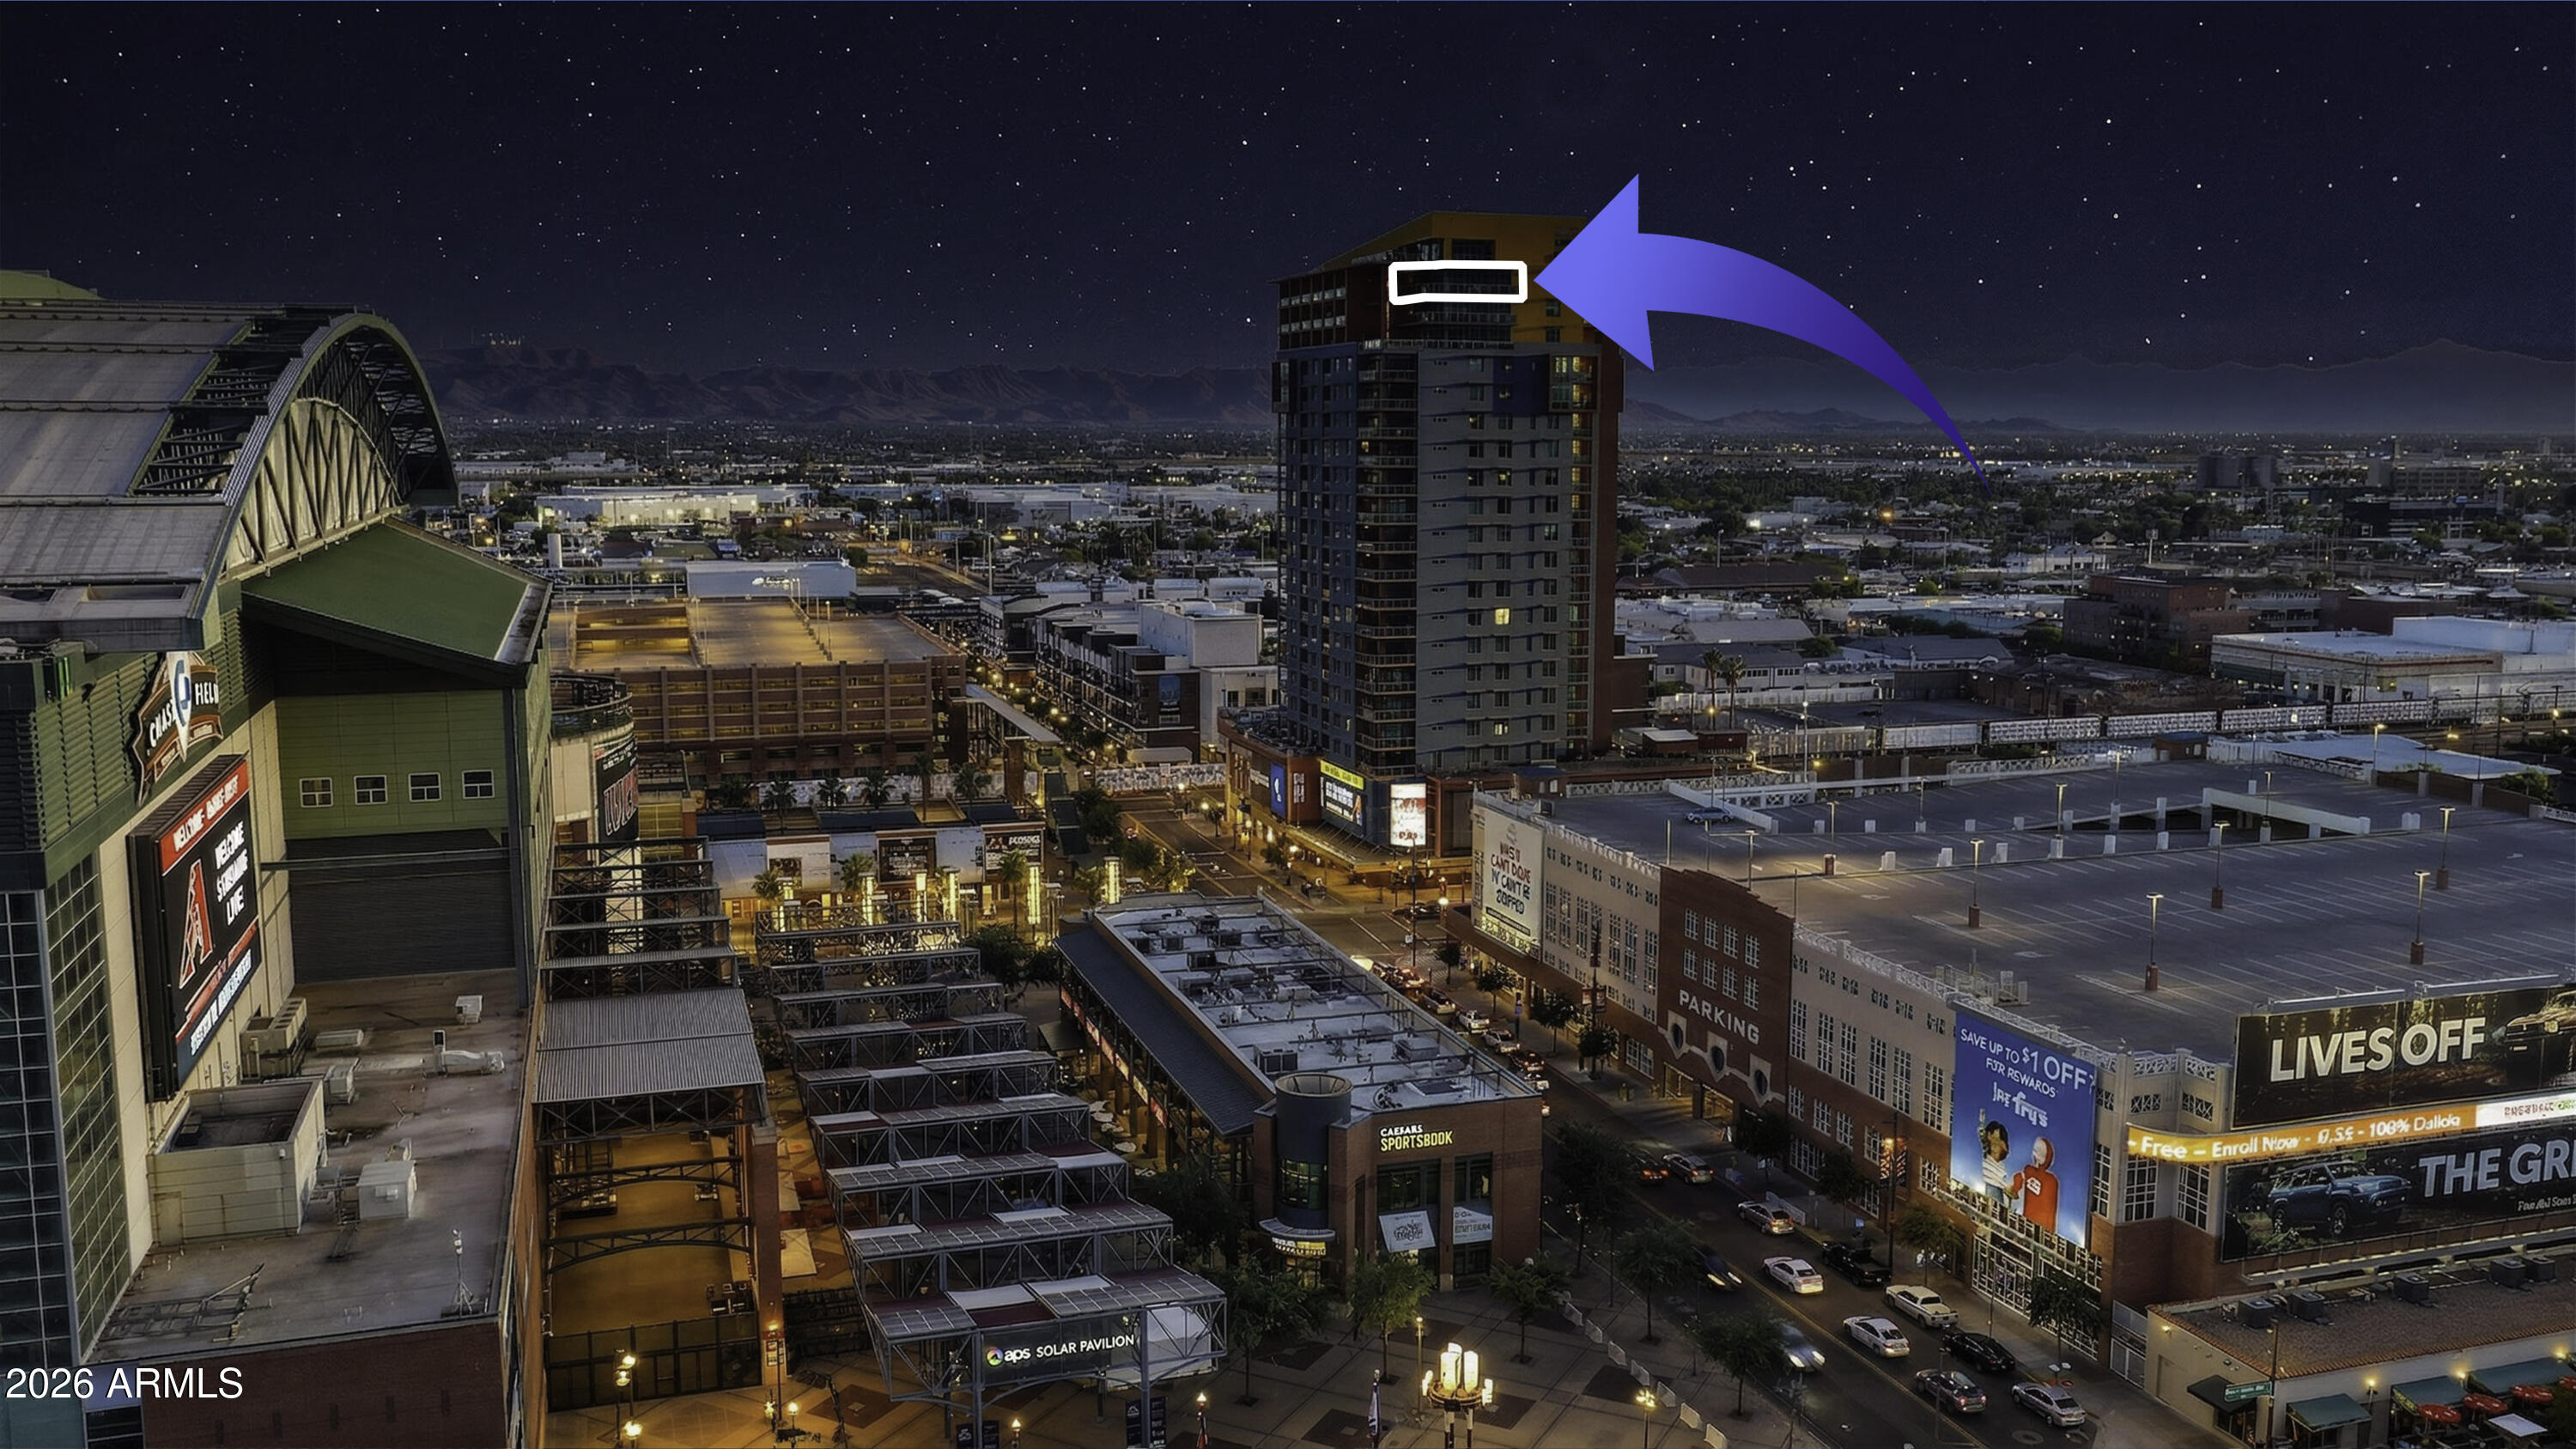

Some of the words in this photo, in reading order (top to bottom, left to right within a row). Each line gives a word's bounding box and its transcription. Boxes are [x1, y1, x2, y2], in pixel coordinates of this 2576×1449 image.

[1680, 989, 1759, 1044] PARKING
[1960, 1028, 1987, 1050] SAVE
[1989, 1040, 2003, 1056] UP
[2005, 1047, 2020, 1064] TO
[2022, 1047, 2038, 1073] $1
[2270, 1027, 2394, 1082] LIVES
[2401, 1017, 2486, 1067] OFF
[1381, 1130, 1453, 1152] SPORTSBOOK
[2141, 1135, 2188, 1159] Free
[2212, 1135, 2257, 1158] Enroll
[2419, 1148, 2501, 1197] THE
[1004, 1348, 1030, 1363] aps
[1036, 1342, 1077, 1358] SOLAR
[1080, 1334, 1134, 1352] PAVILION
